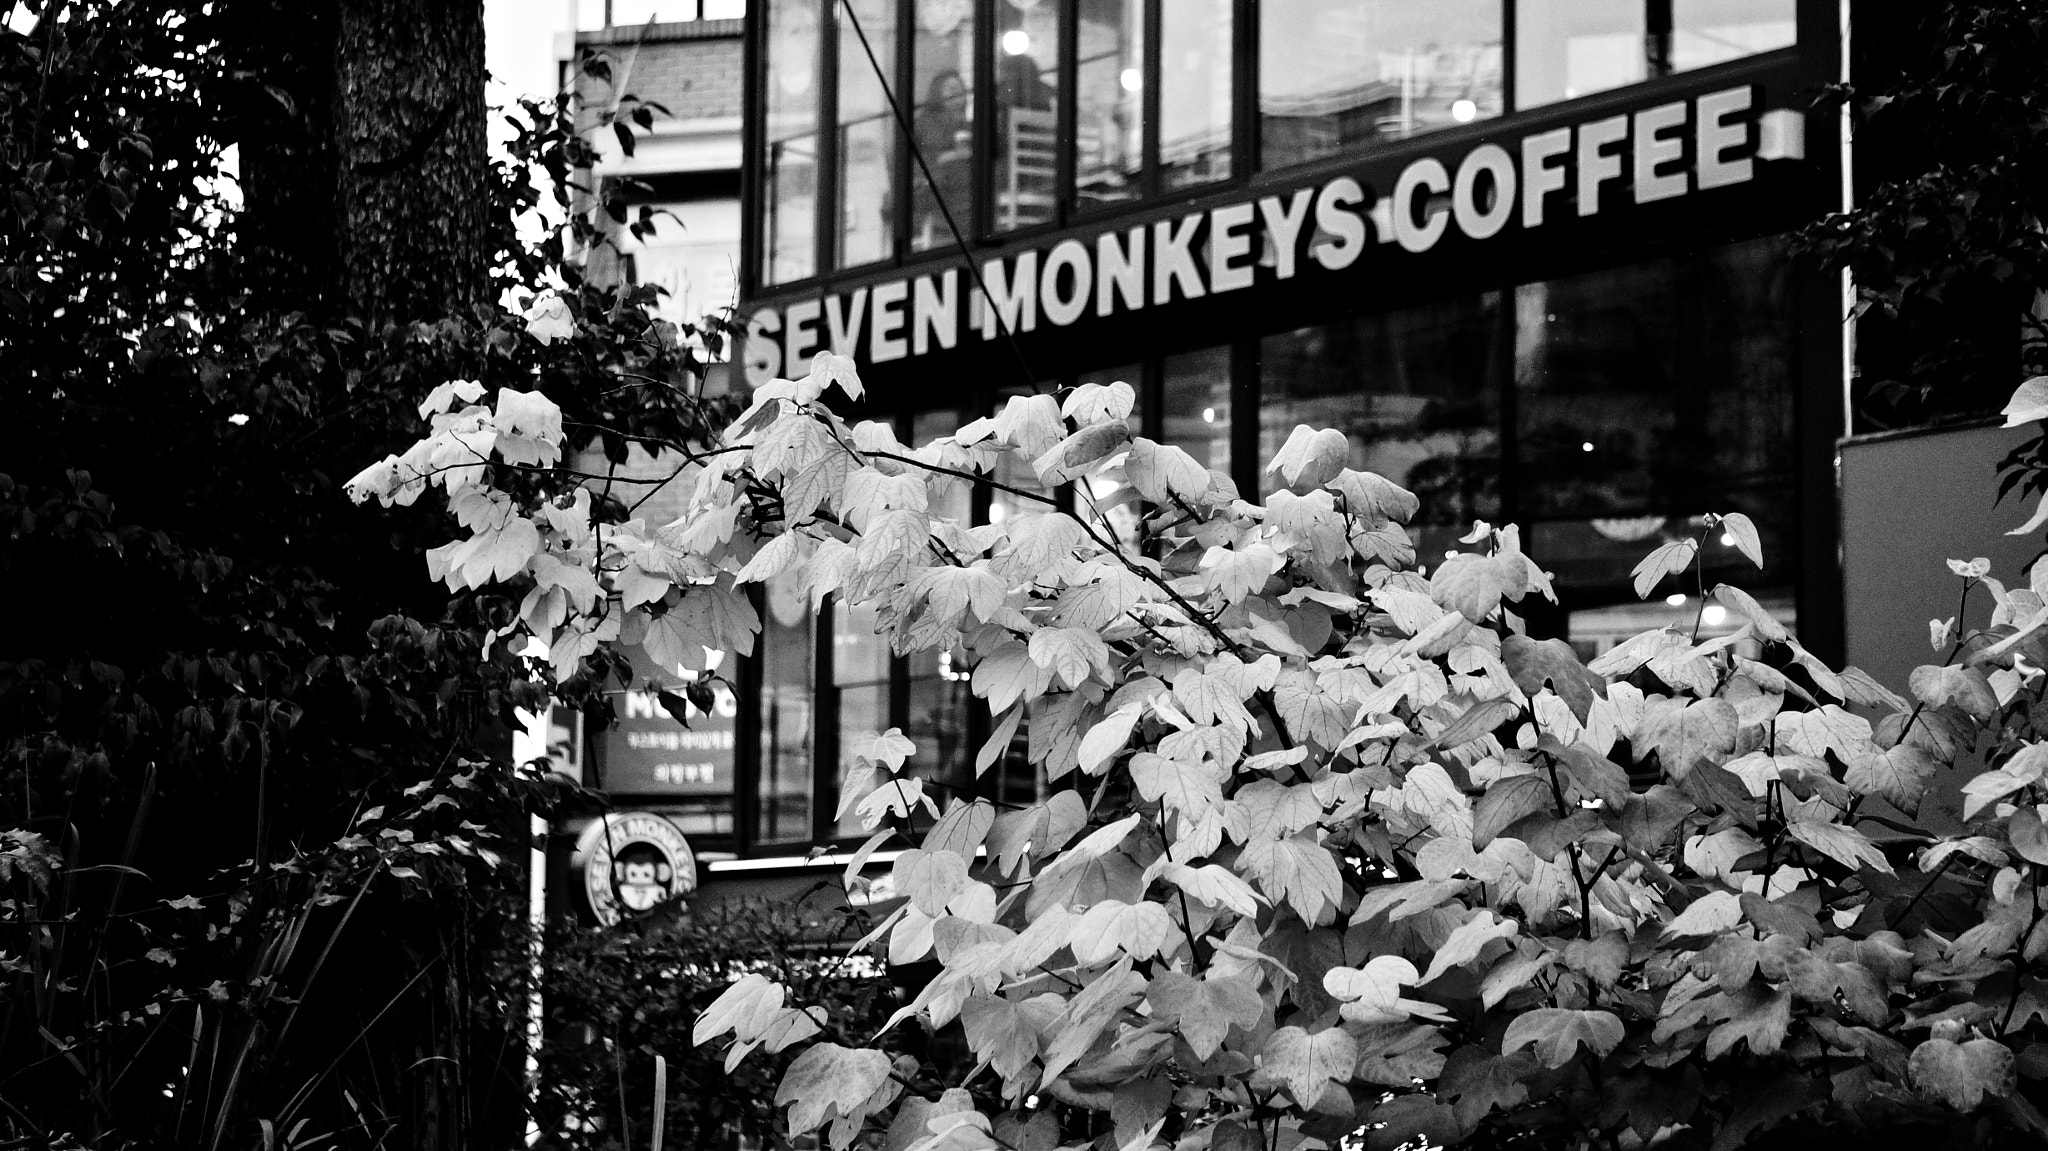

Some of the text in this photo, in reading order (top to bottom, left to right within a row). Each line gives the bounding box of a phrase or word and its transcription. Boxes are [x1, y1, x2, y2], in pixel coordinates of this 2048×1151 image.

[744, 85, 1753, 388] SEVEN MONKEYS COFFEE
